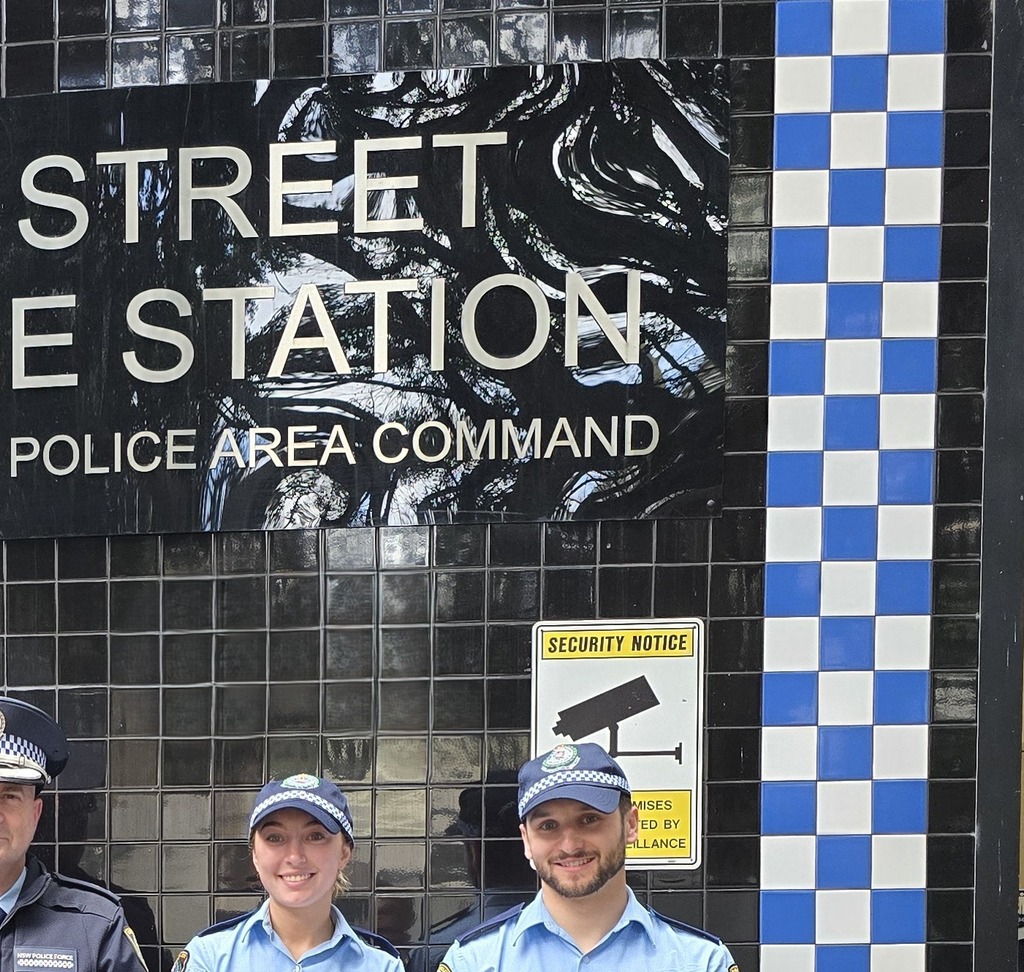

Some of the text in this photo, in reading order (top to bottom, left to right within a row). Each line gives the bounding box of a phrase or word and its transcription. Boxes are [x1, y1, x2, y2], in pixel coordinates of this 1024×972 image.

[17, 131, 508, 251] STREET
[122, 270, 643, 384] STATION
[10, 428, 197, 478] POLICE
[210, 424, 357, 469] AREA
[372, 414, 660, 465] COMMAND
[548, 634, 687, 653] SECURITY NOTICE
[664, 819, 681, 830] BY
[53, 954, 74, 962] FORCE
